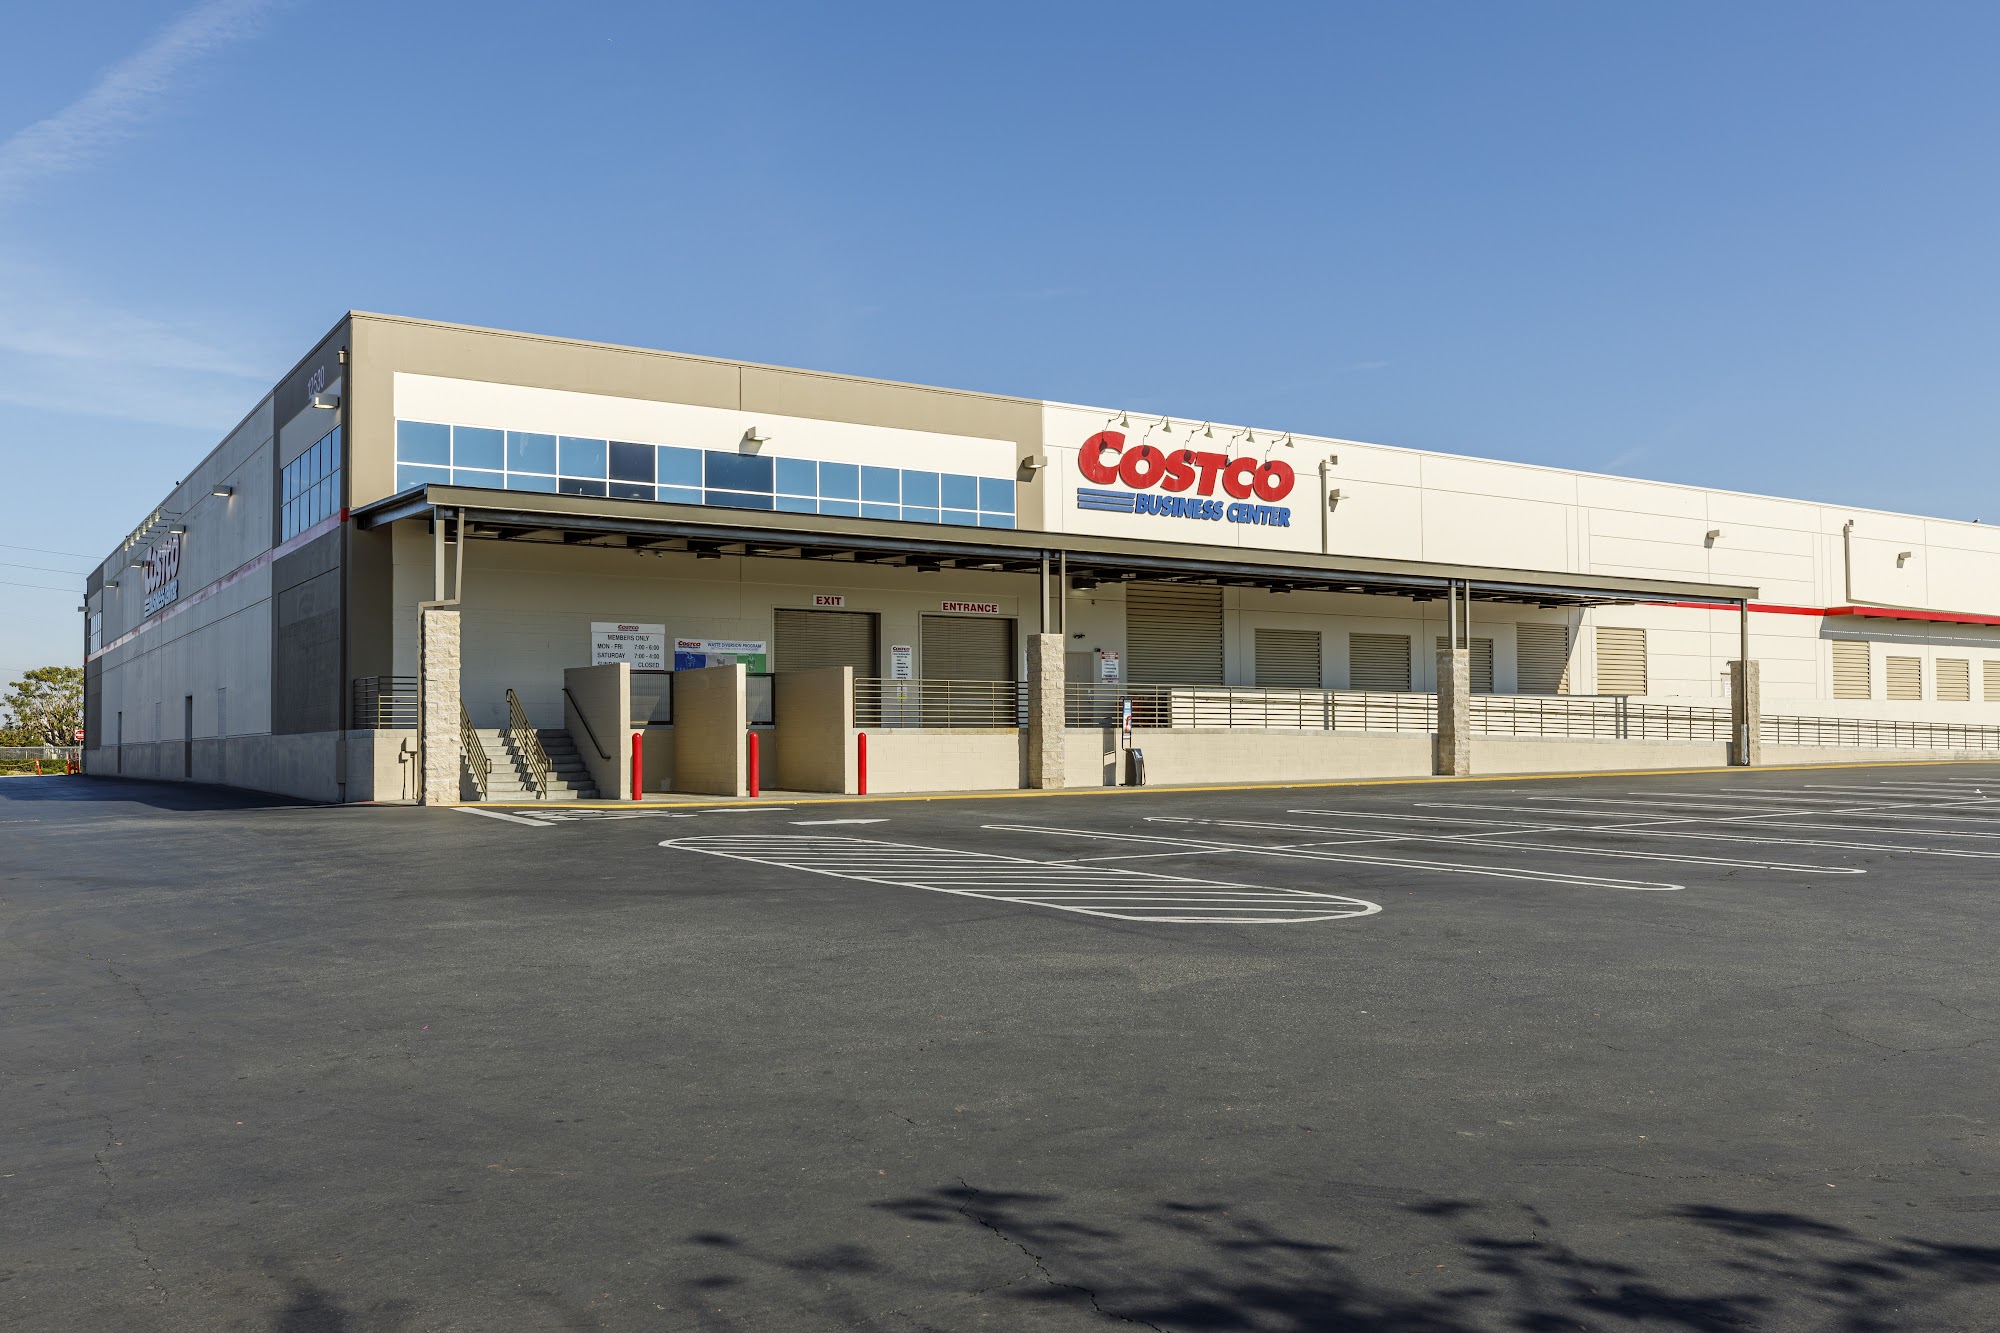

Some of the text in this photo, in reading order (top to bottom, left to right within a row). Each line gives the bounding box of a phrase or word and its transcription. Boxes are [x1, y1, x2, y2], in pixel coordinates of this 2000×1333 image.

[1078, 430, 1295, 502] COSTCO
[1135, 492, 1292, 528] BUSINESS CENTER
[815, 596, 842, 606] EXIT
[942, 602, 998, 613] ENTRANCE
